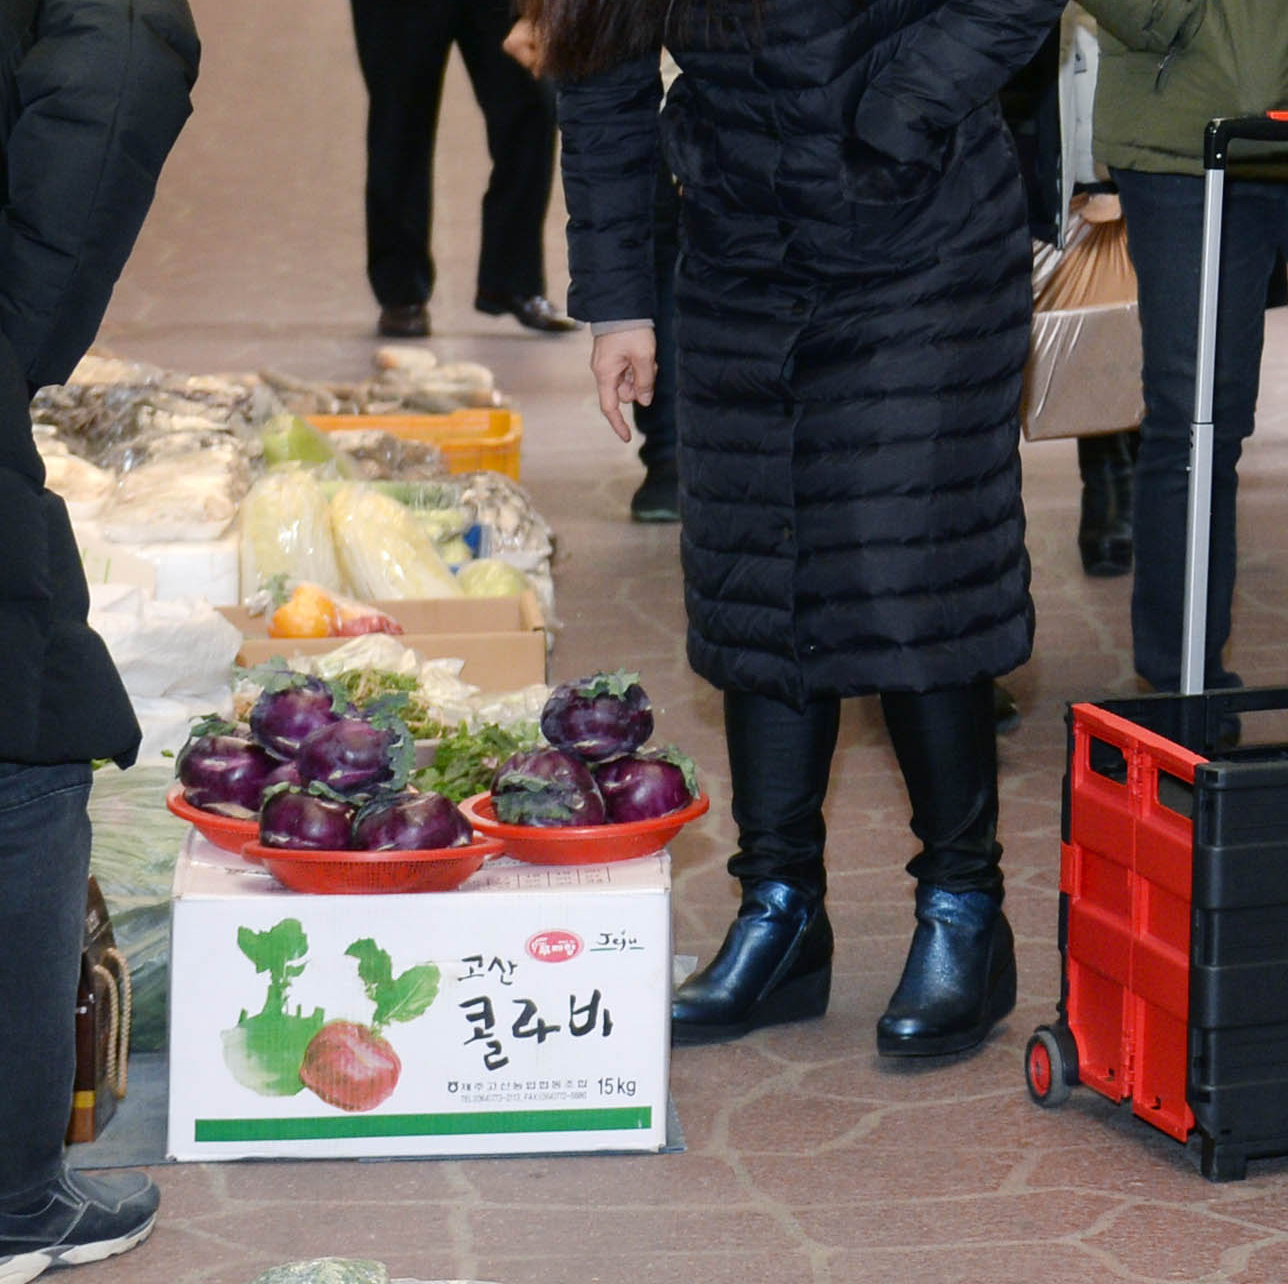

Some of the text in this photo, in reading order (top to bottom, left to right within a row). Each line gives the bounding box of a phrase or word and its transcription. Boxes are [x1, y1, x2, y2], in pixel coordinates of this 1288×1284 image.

[597, 929, 637, 952] Jeju
[457, 954, 518, 986] 고산
[458, 988, 614, 1072] 콜라비
